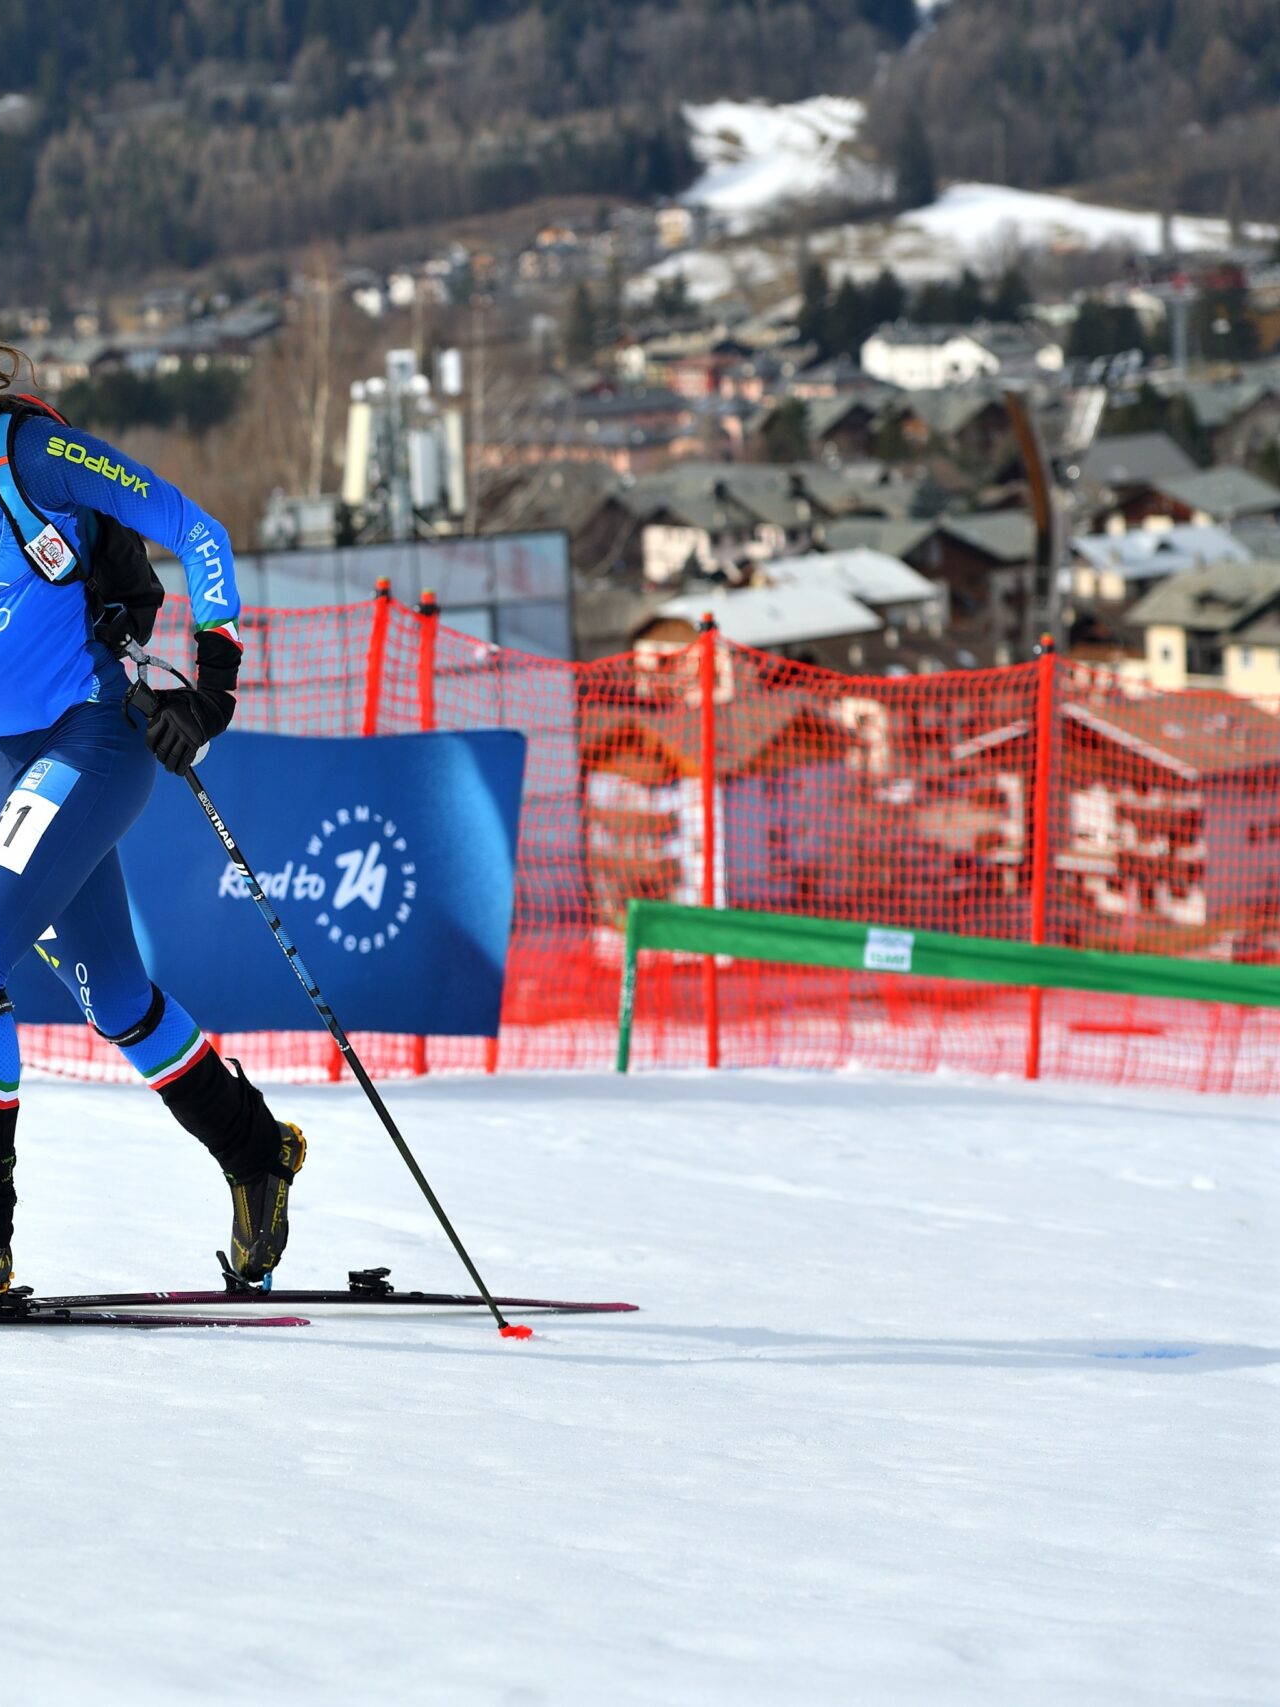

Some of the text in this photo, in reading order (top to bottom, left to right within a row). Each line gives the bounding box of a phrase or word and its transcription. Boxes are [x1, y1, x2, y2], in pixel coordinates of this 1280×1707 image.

[46, 436, 151, 499] KARPOS
[306, 805, 407, 856] WARM-UP
[293, 864, 326, 901] to
[316, 862, 417, 954] PROGRAMME
